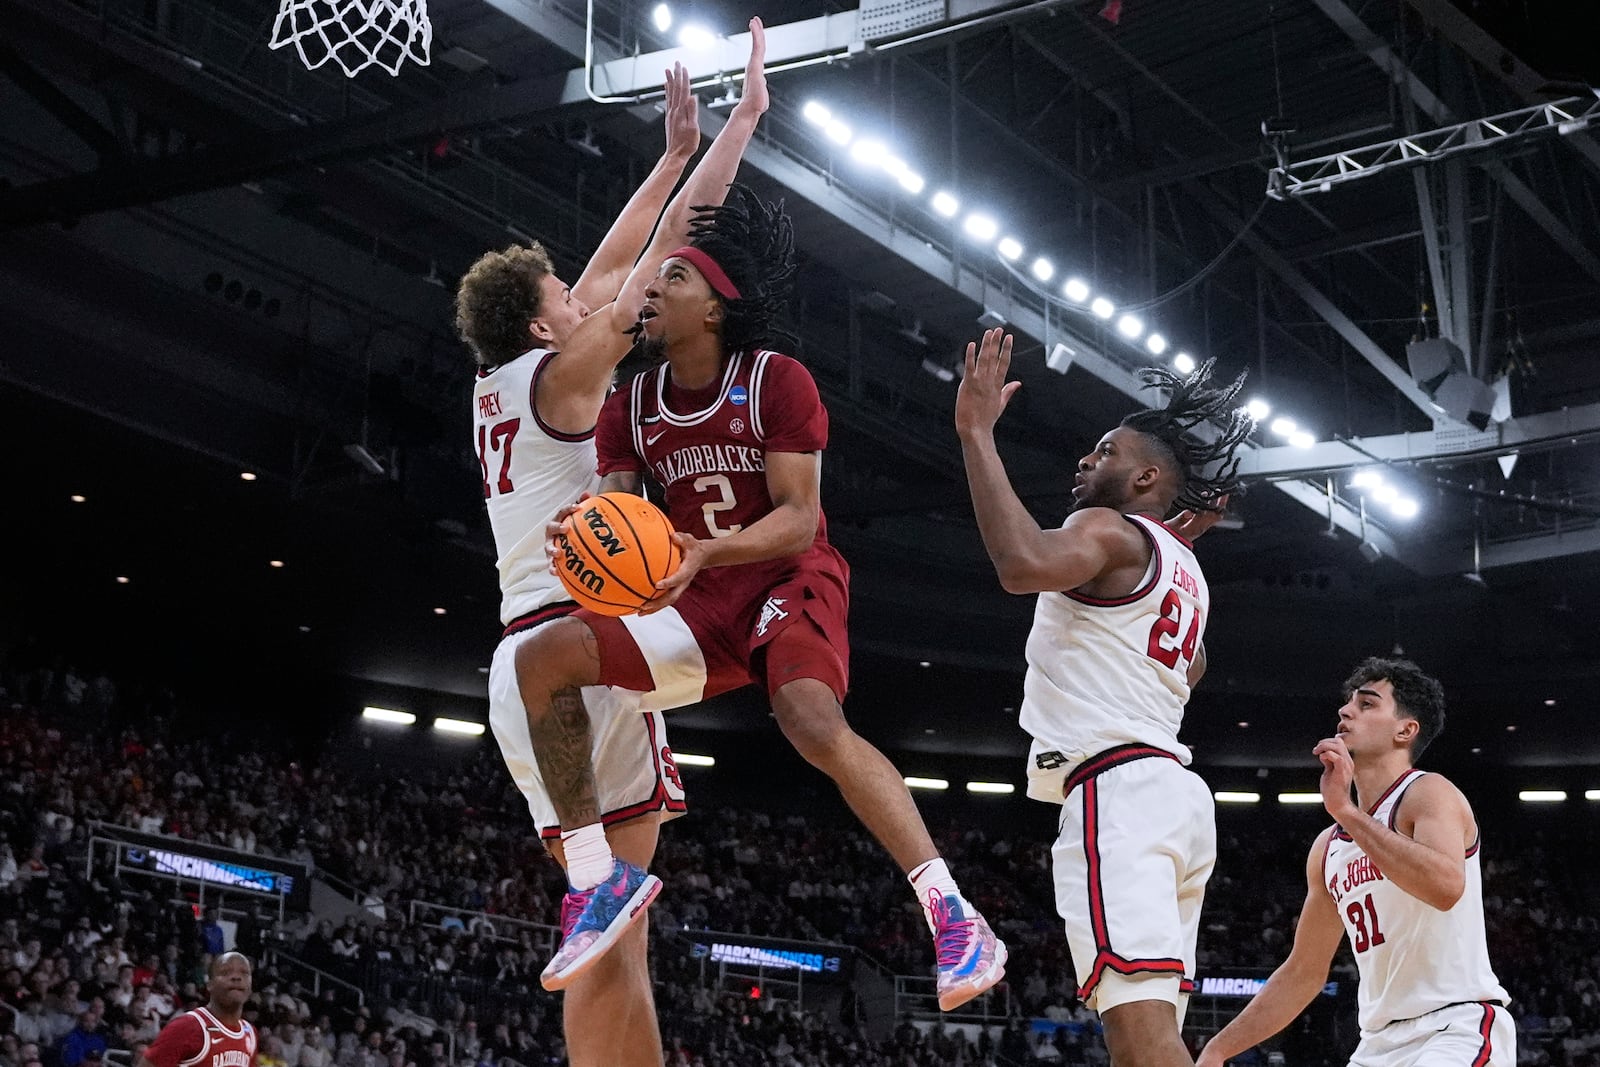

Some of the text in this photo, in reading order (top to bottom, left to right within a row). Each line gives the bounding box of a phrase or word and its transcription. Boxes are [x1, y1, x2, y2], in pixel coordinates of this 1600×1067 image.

[479, 391, 502, 418] PREY
[479, 417, 520, 499] 17
[656, 445, 765, 487] RAZORBACKS
[583, 506, 627, 557] NCAA
[693, 473, 742, 538] 2
[560, 533, 605, 595] Wilso
[1147, 588, 1200, 671] 24
[1343, 855, 1384, 892] JOHN
[1346, 893, 1386, 954] 31
